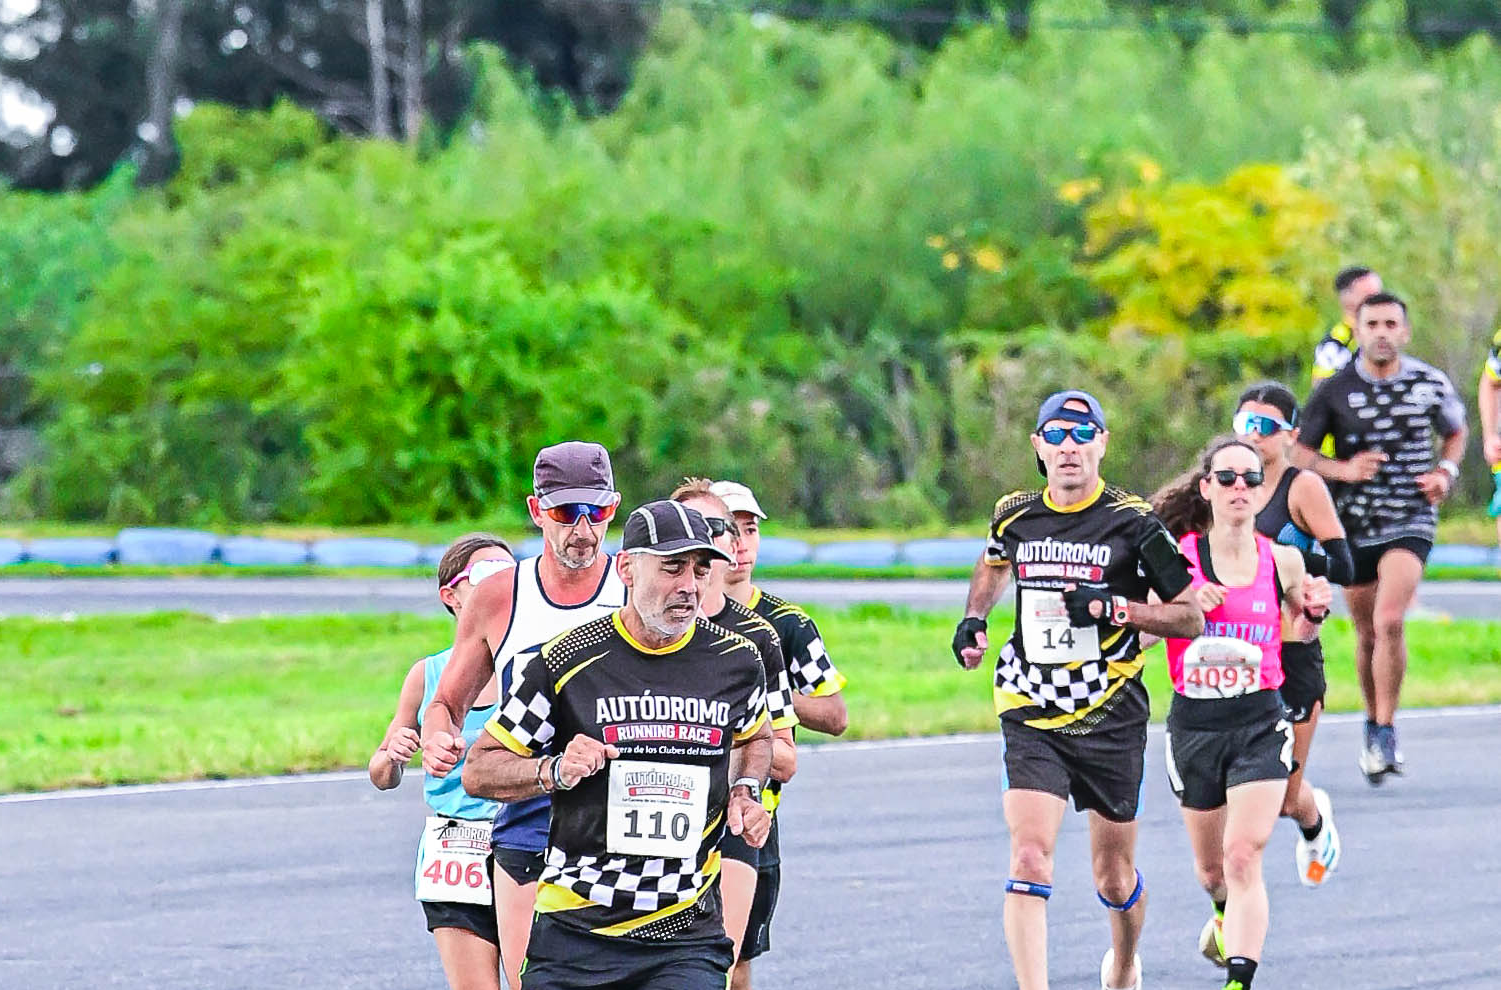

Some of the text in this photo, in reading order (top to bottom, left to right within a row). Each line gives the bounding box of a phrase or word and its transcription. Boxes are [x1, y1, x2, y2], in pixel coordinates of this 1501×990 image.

[1016, 536, 1111, 567] AUTÓDROMO
[1042, 627, 1075, 649] 14
[1186, 667, 1256, 689] 4093
[596, 689, 730, 726] AUTÓDROMO
[617, 724, 712, 744] RUNNING RACE
[634, 744, 644, 754] de
[645, 744, 657, 754] los
[658, 745, 685, 755] Clubes
[687, 746, 699, 756] del
[624, 809, 690, 841] 110
[423, 859, 491, 890] 406
